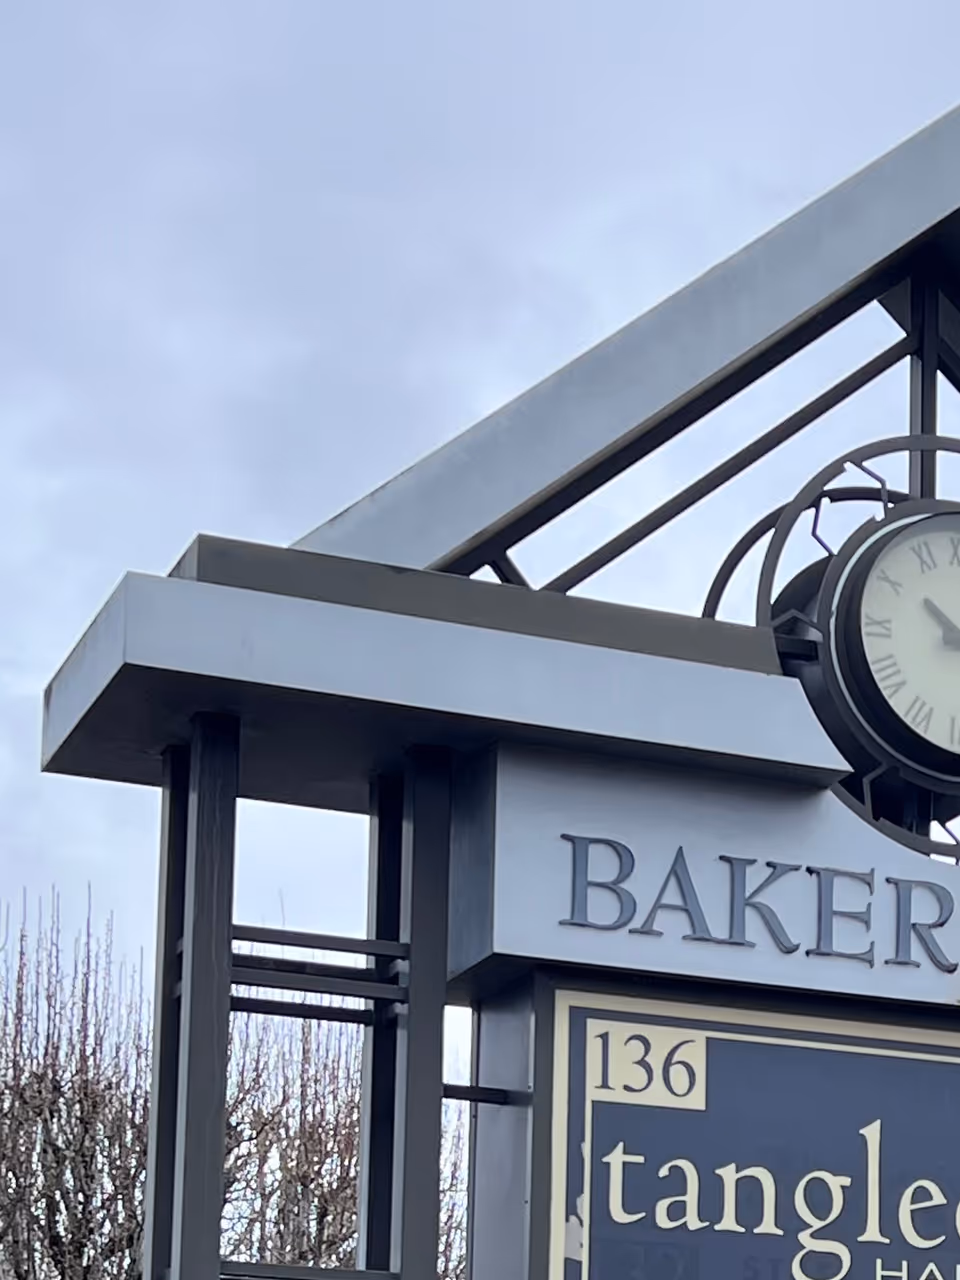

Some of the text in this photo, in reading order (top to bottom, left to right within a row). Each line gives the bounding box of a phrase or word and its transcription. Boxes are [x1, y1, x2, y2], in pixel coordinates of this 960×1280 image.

[910, 541, 938, 574] XI
[876, 569, 904, 596] X
[558, 831, 959, 974] BAKER
[595, 1032, 696, 1097] 136
